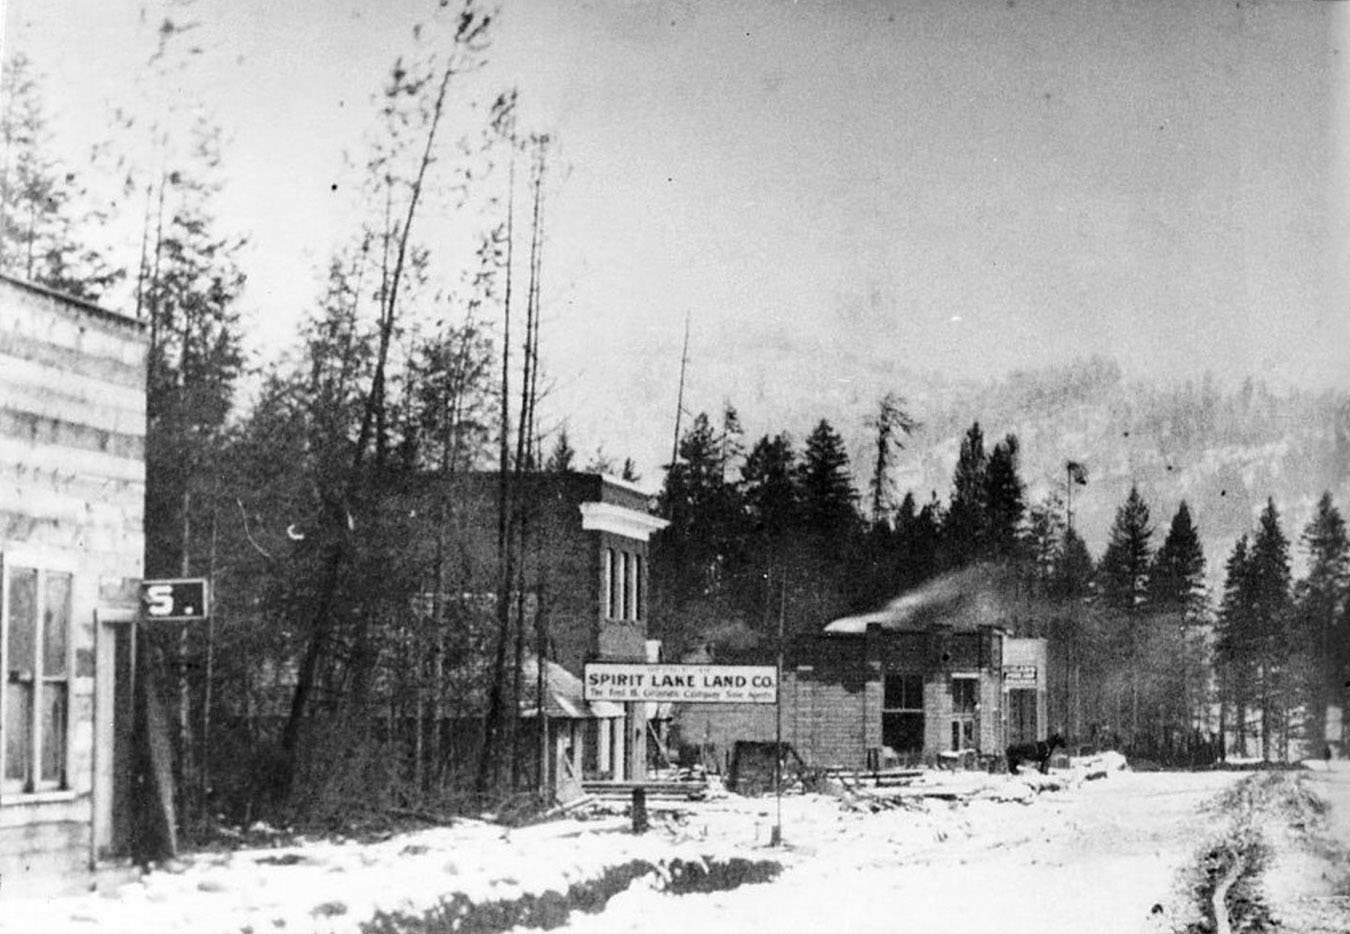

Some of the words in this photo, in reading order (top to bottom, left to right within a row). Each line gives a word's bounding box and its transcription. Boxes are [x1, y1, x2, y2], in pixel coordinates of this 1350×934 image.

[588, 673, 645, 686] SPIRIT
[651, 674, 695, 688] LAKE
[703, 675, 747, 688] LAND
